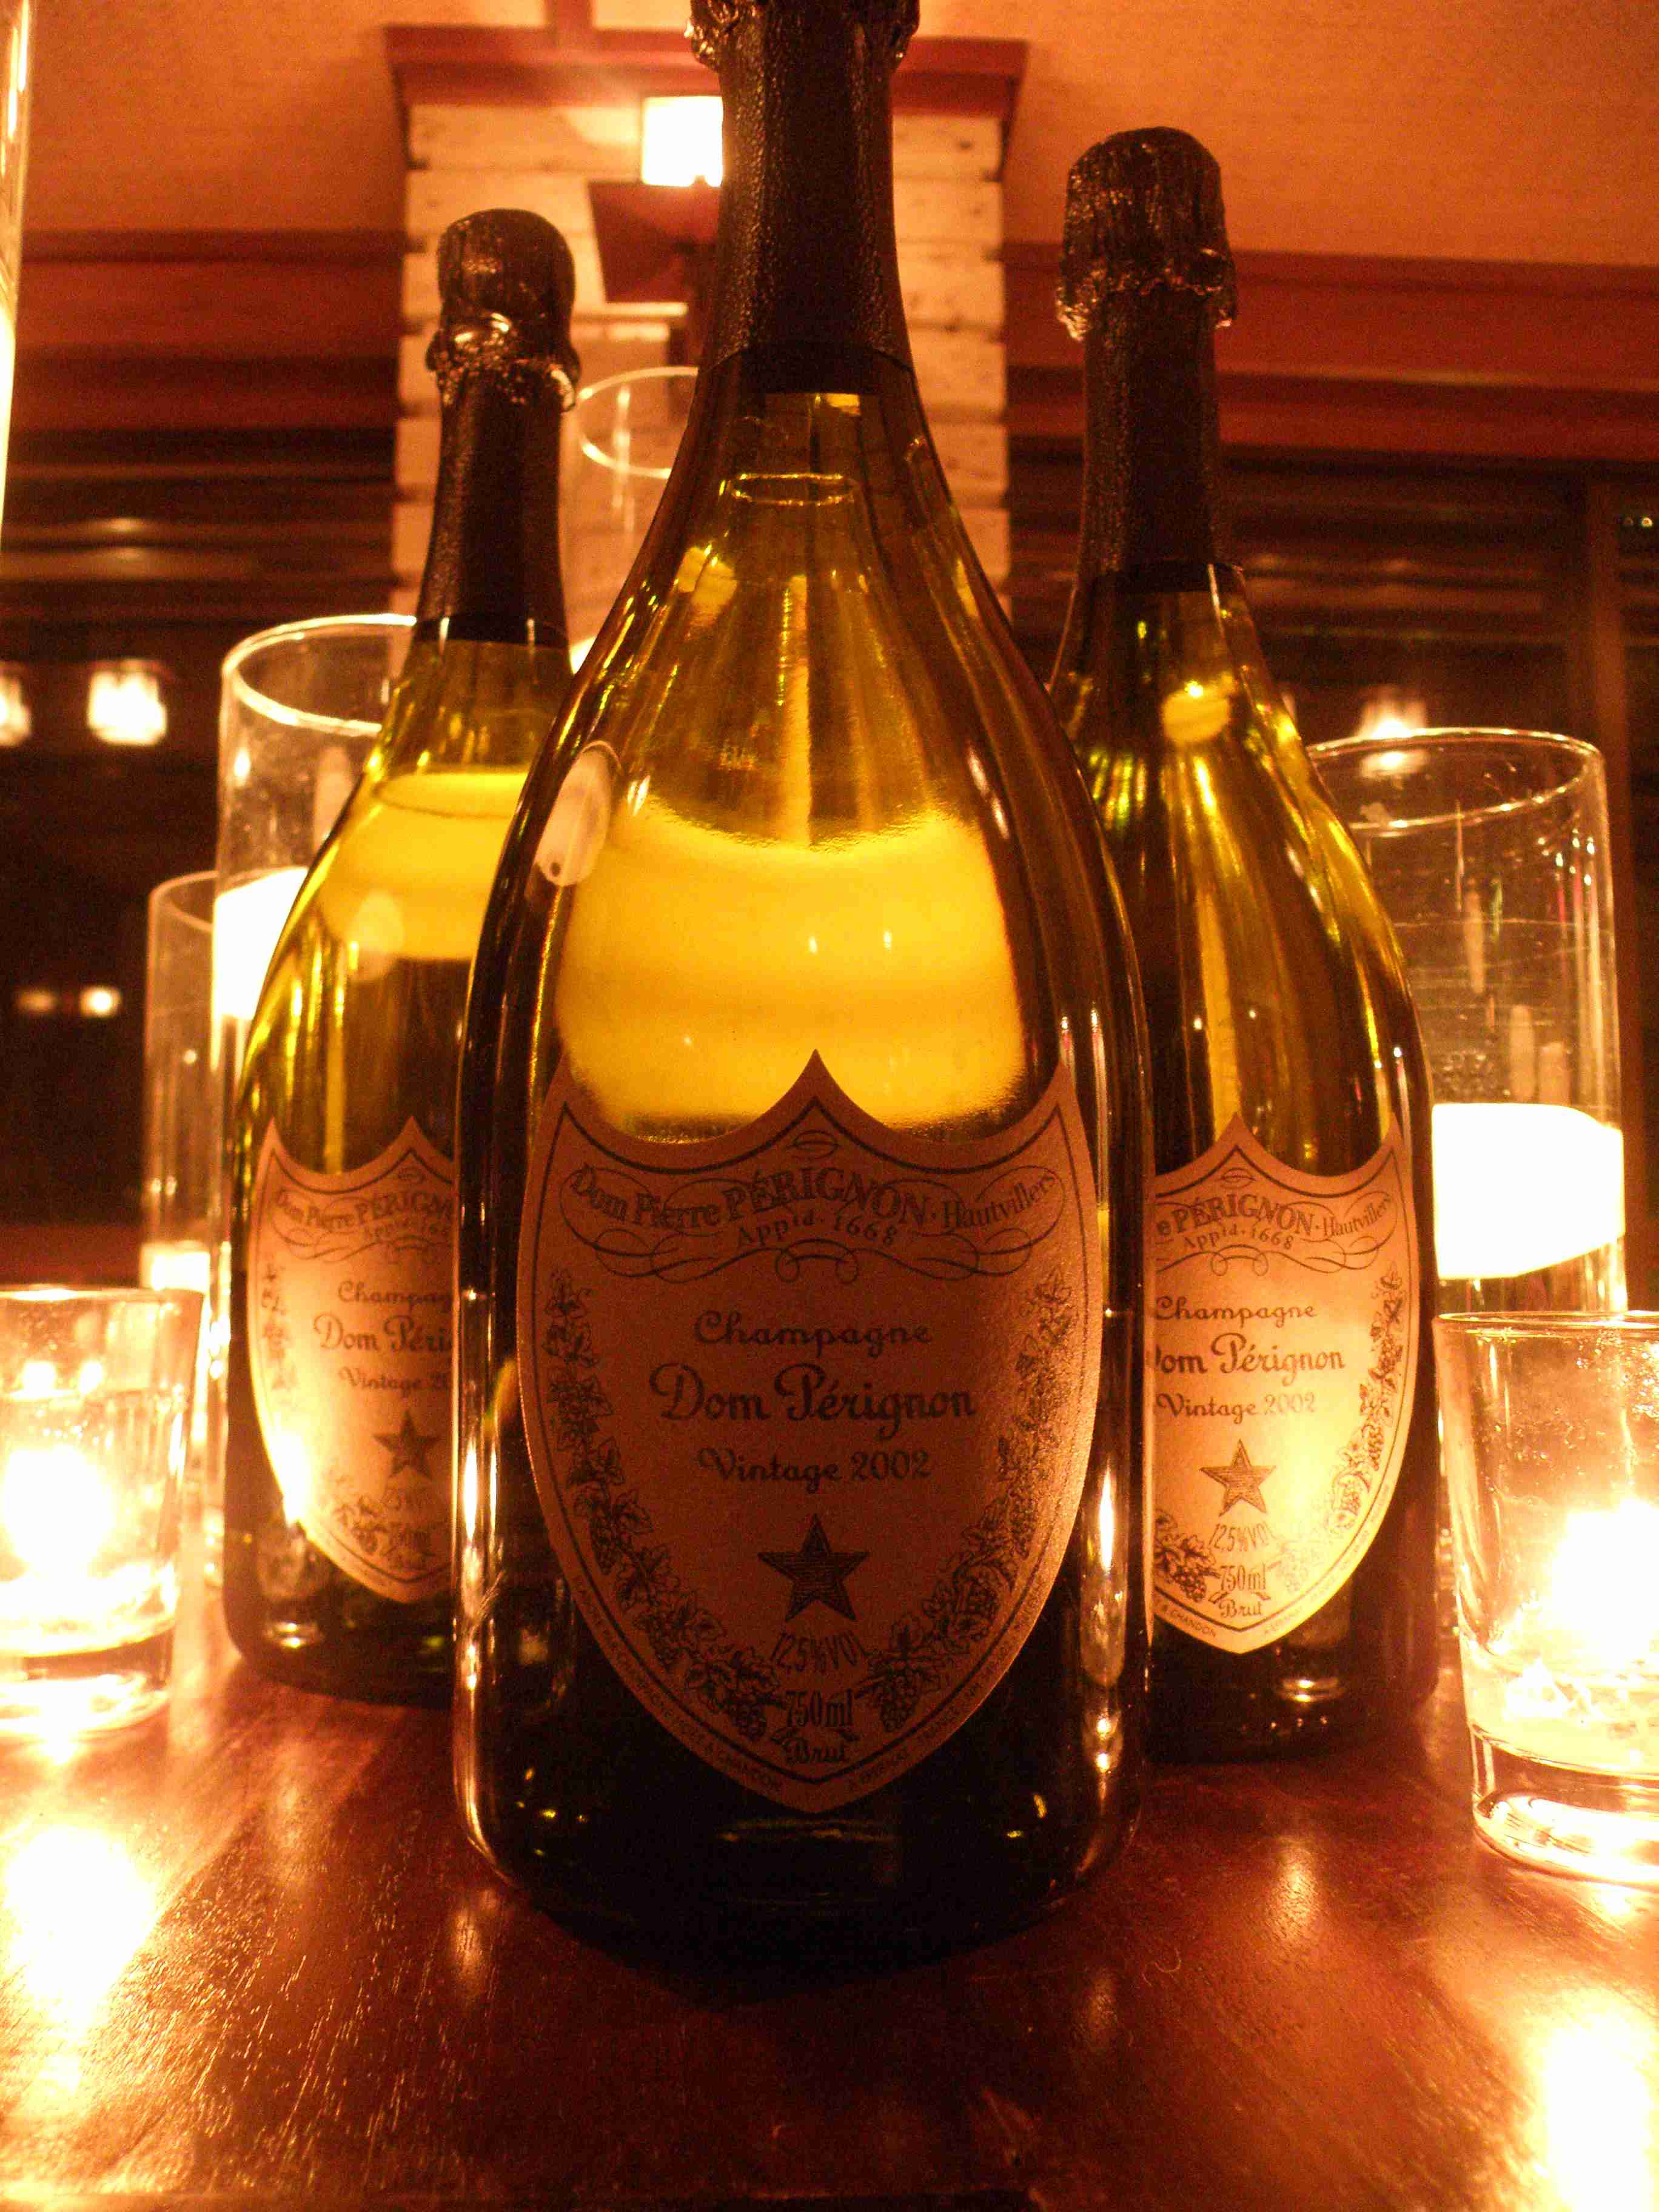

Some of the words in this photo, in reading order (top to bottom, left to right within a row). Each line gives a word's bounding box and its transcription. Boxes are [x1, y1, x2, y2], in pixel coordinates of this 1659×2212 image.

[1251, 1227, 1294, 1250] 1668
[1154, 1295, 1317, 1329] Champagne
[313, 1312, 380, 1353] Dom
[695, 1310, 933, 1359] Champagne
[1211, 1332, 1345, 1388] Pérignon
[338, 1366, 423, 1398] Vintage
[649, 1362, 772, 1421] Dom
[774, 1362, 979, 1442] Pérignon
[1154, 1392, 1260, 1425] Vintage
[1262, 1392, 1316, 1416] 2002
[699, 1447, 843, 1495] Vintage
[850, 1450, 933, 1481] 2002
[1219, 1563, 1267, 1592] 750ml
[1218, 1598, 1264, 1620] Brut
[785, 1687, 853, 1728] 750ml
[783, 1737, 846, 1766] Brut
